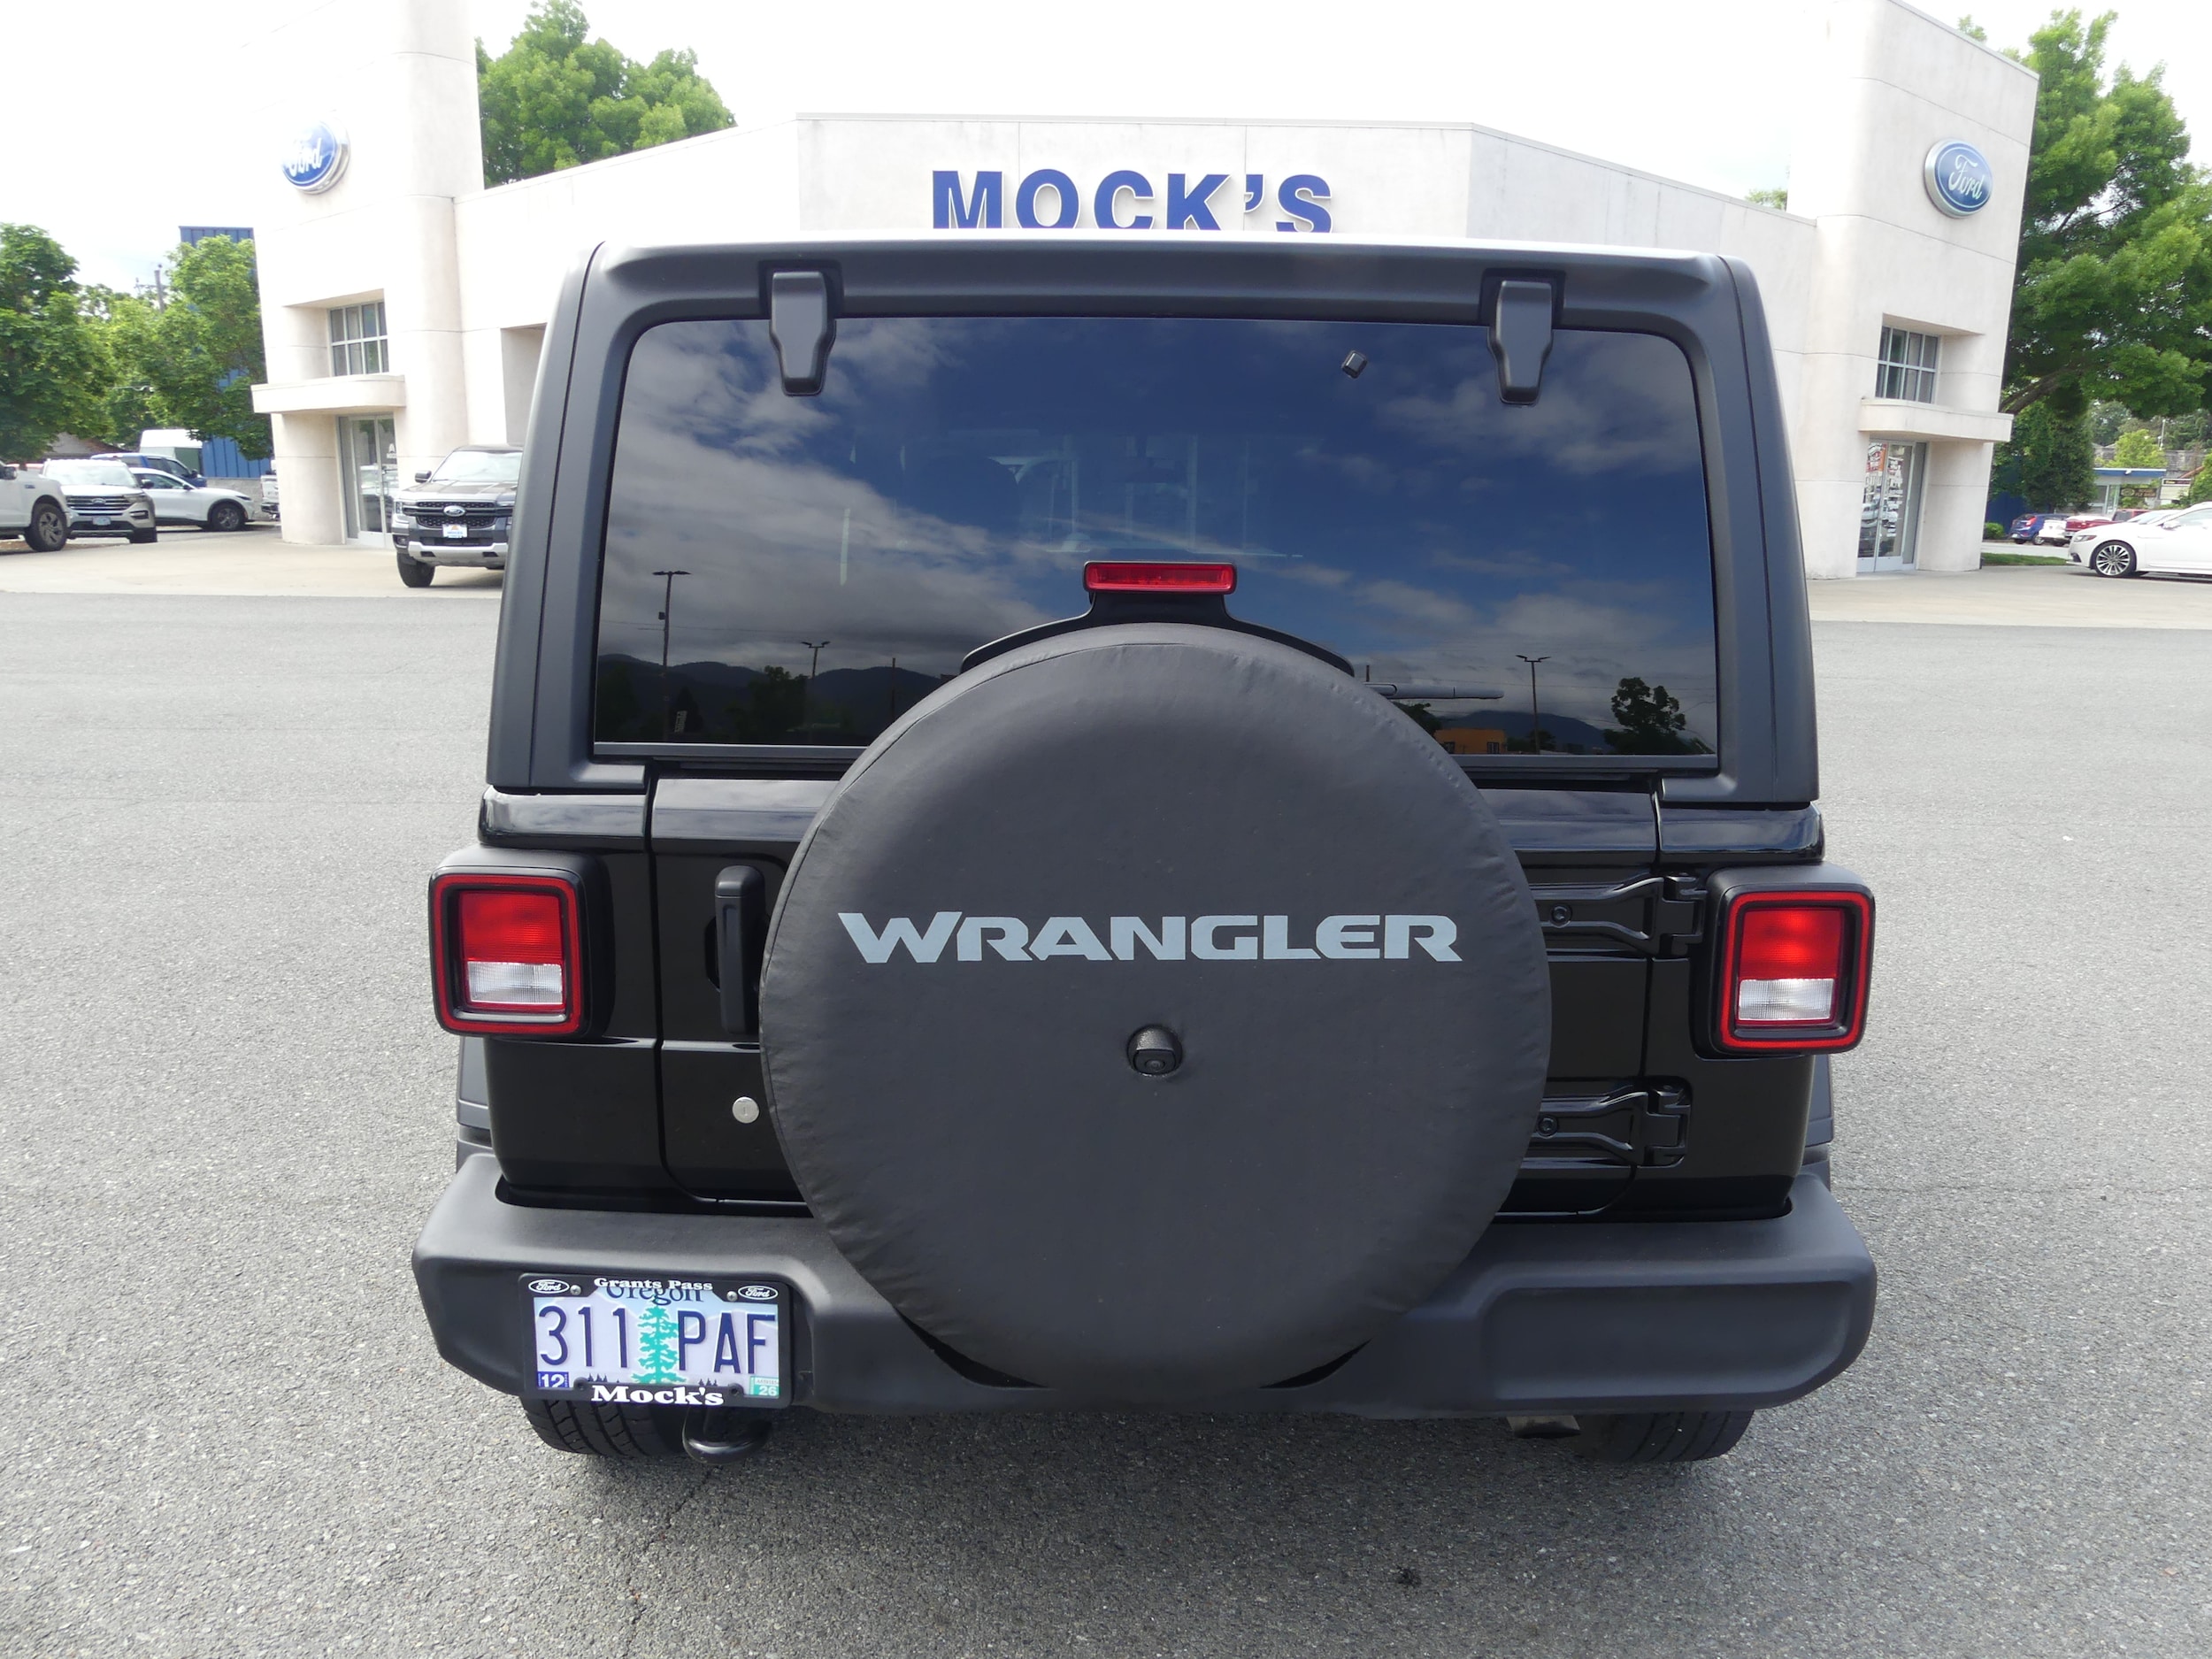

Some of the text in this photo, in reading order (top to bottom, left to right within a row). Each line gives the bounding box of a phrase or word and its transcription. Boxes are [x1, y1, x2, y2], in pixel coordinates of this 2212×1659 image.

[1948, 154, 1985, 200] Ford
[932, 169, 1333, 234] MOCK'S
[837, 910, 1463, 964] WRANGLER
[535, 1281, 562, 1291] Ford
[594, 1278, 713, 1291] Grants Pass
[745, 1287, 770, 1297] Ford
[538, 1305, 776, 1374] 311 PAF
[541, 1373, 565, 1388] 12
[591, 1385, 725, 1406] Mock's
[758, 1386, 778, 1396] 26
